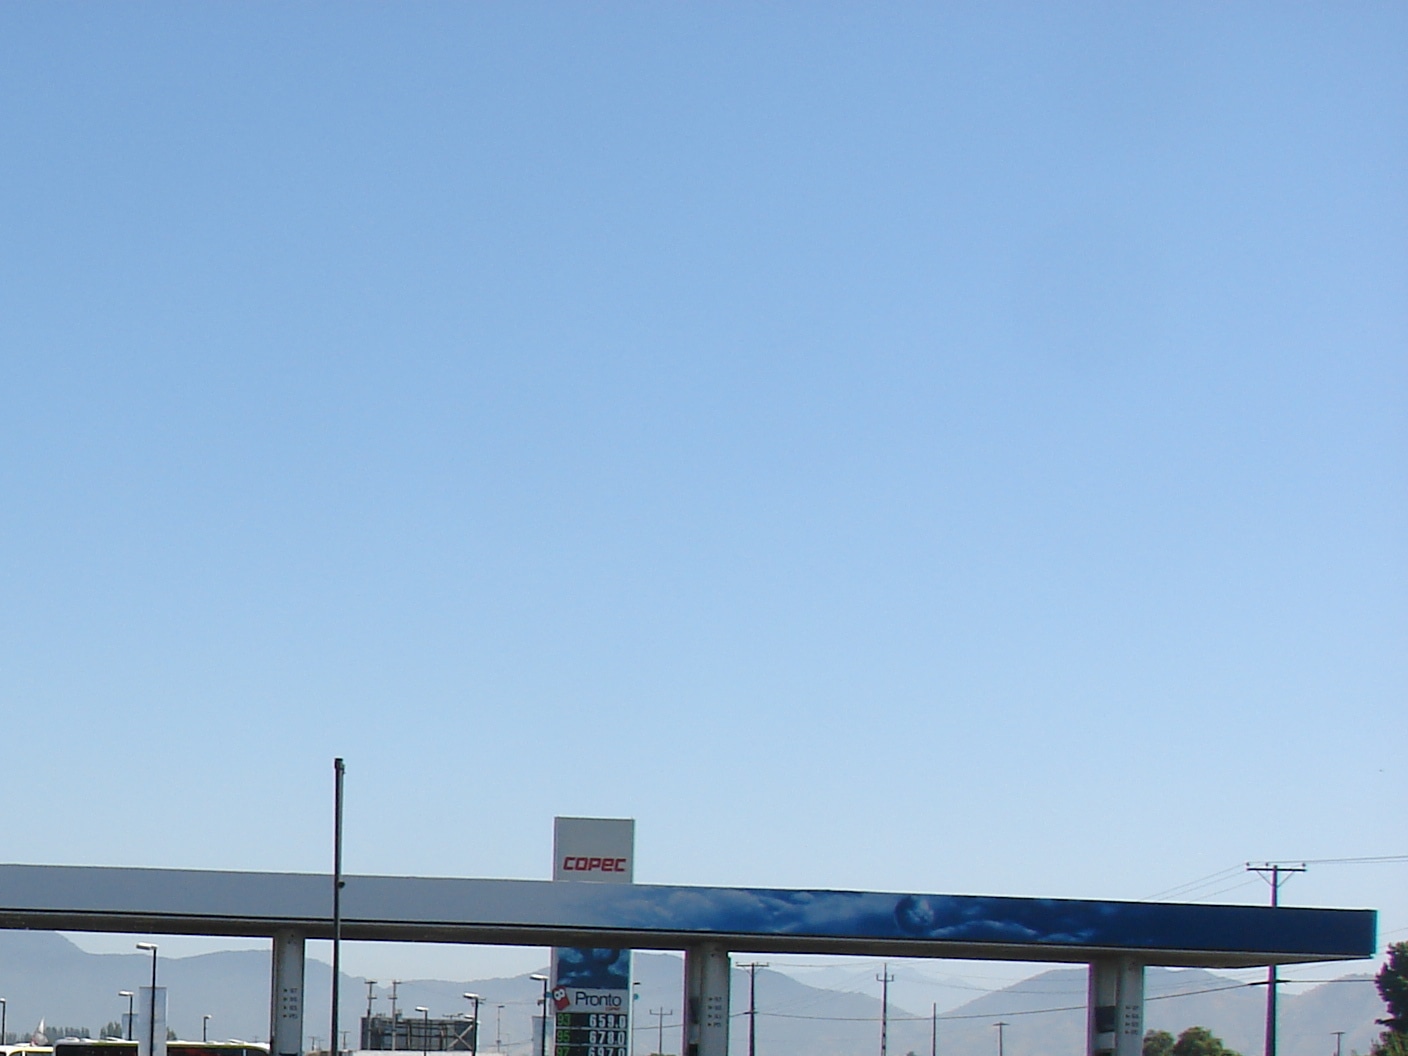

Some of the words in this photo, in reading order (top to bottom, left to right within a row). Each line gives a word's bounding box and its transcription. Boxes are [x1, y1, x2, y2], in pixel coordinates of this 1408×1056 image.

[563, 856, 627, 872] COPEC
[575, 991, 622, 1007] Pronto
[557, 1013, 571, 1026] 93
[589, 1014, 626, 1028] 659.0
[557, 1030, 570, 1042] 95
[589, 1031, 625, 1045] 678.0
